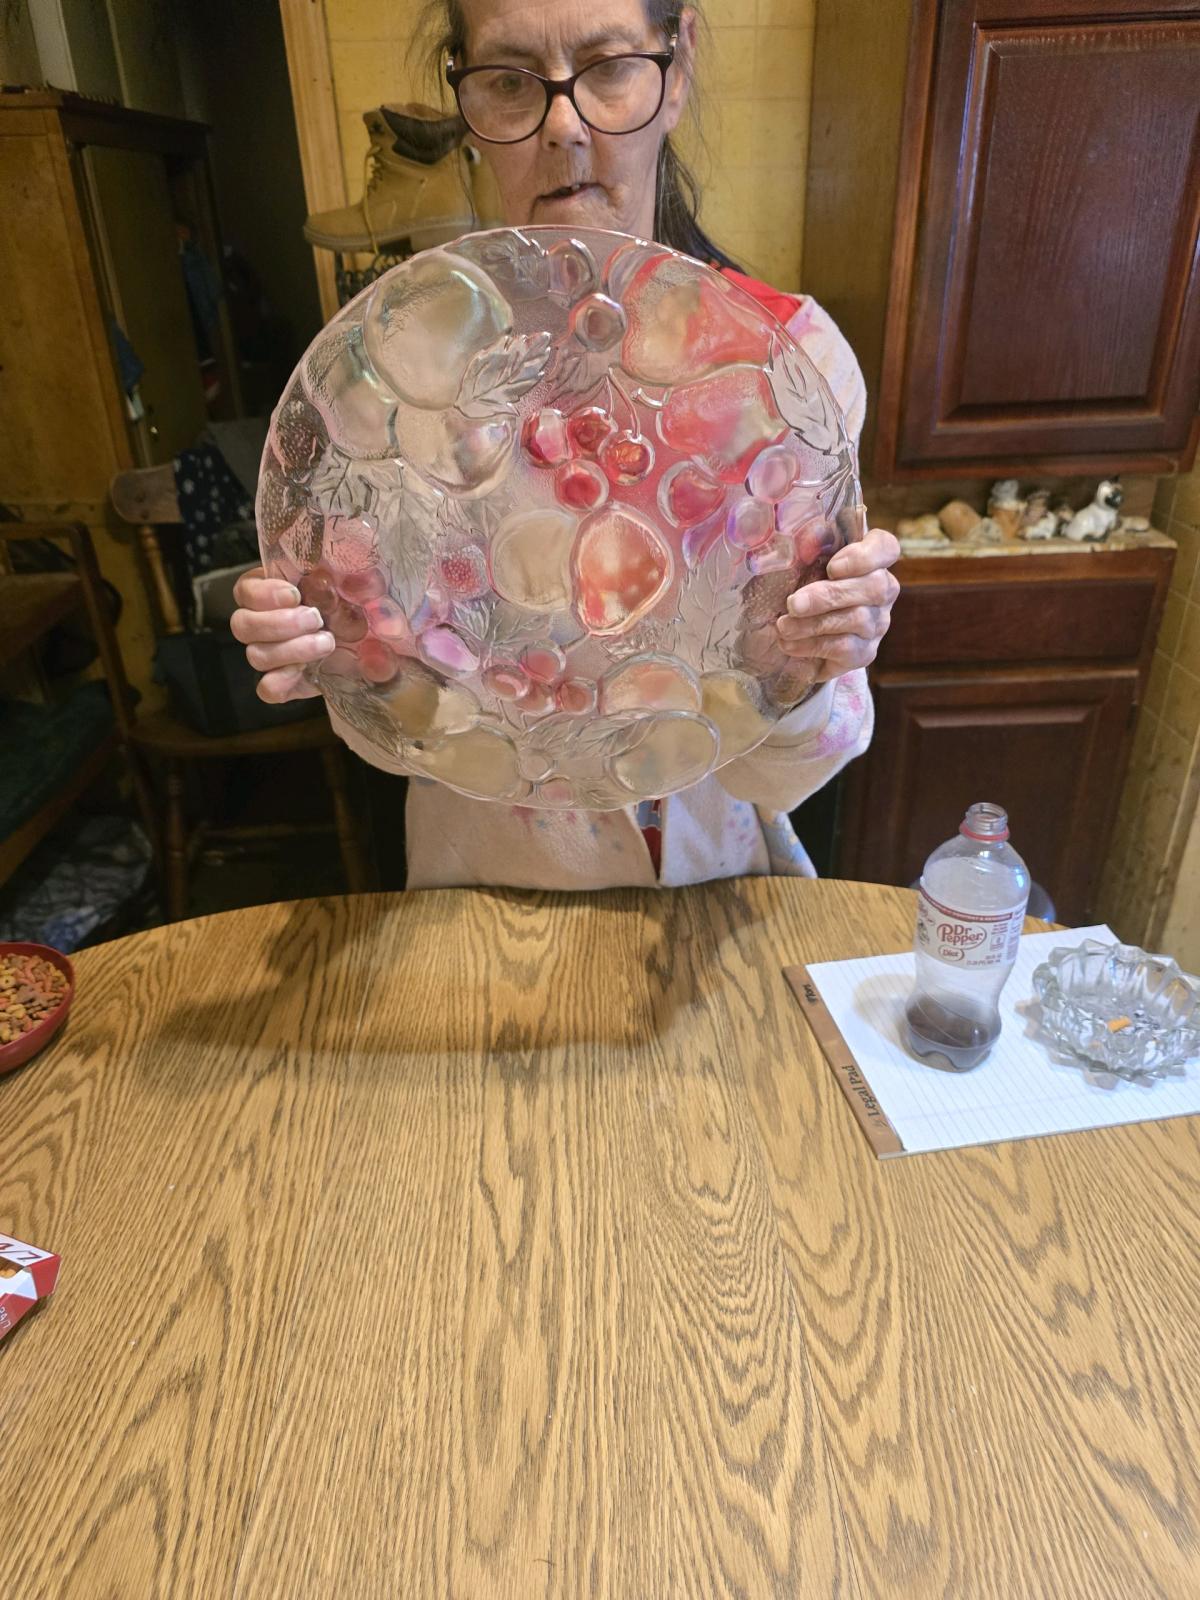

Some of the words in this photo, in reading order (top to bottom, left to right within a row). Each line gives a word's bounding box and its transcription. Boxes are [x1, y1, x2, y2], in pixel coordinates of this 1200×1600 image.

[937, 923, 984, 946] Pepper
[954, 924, 972, 936] Dr
[842, 1065, 862, 1086] Pad
[853, 1086, 880, 1117] Legal
